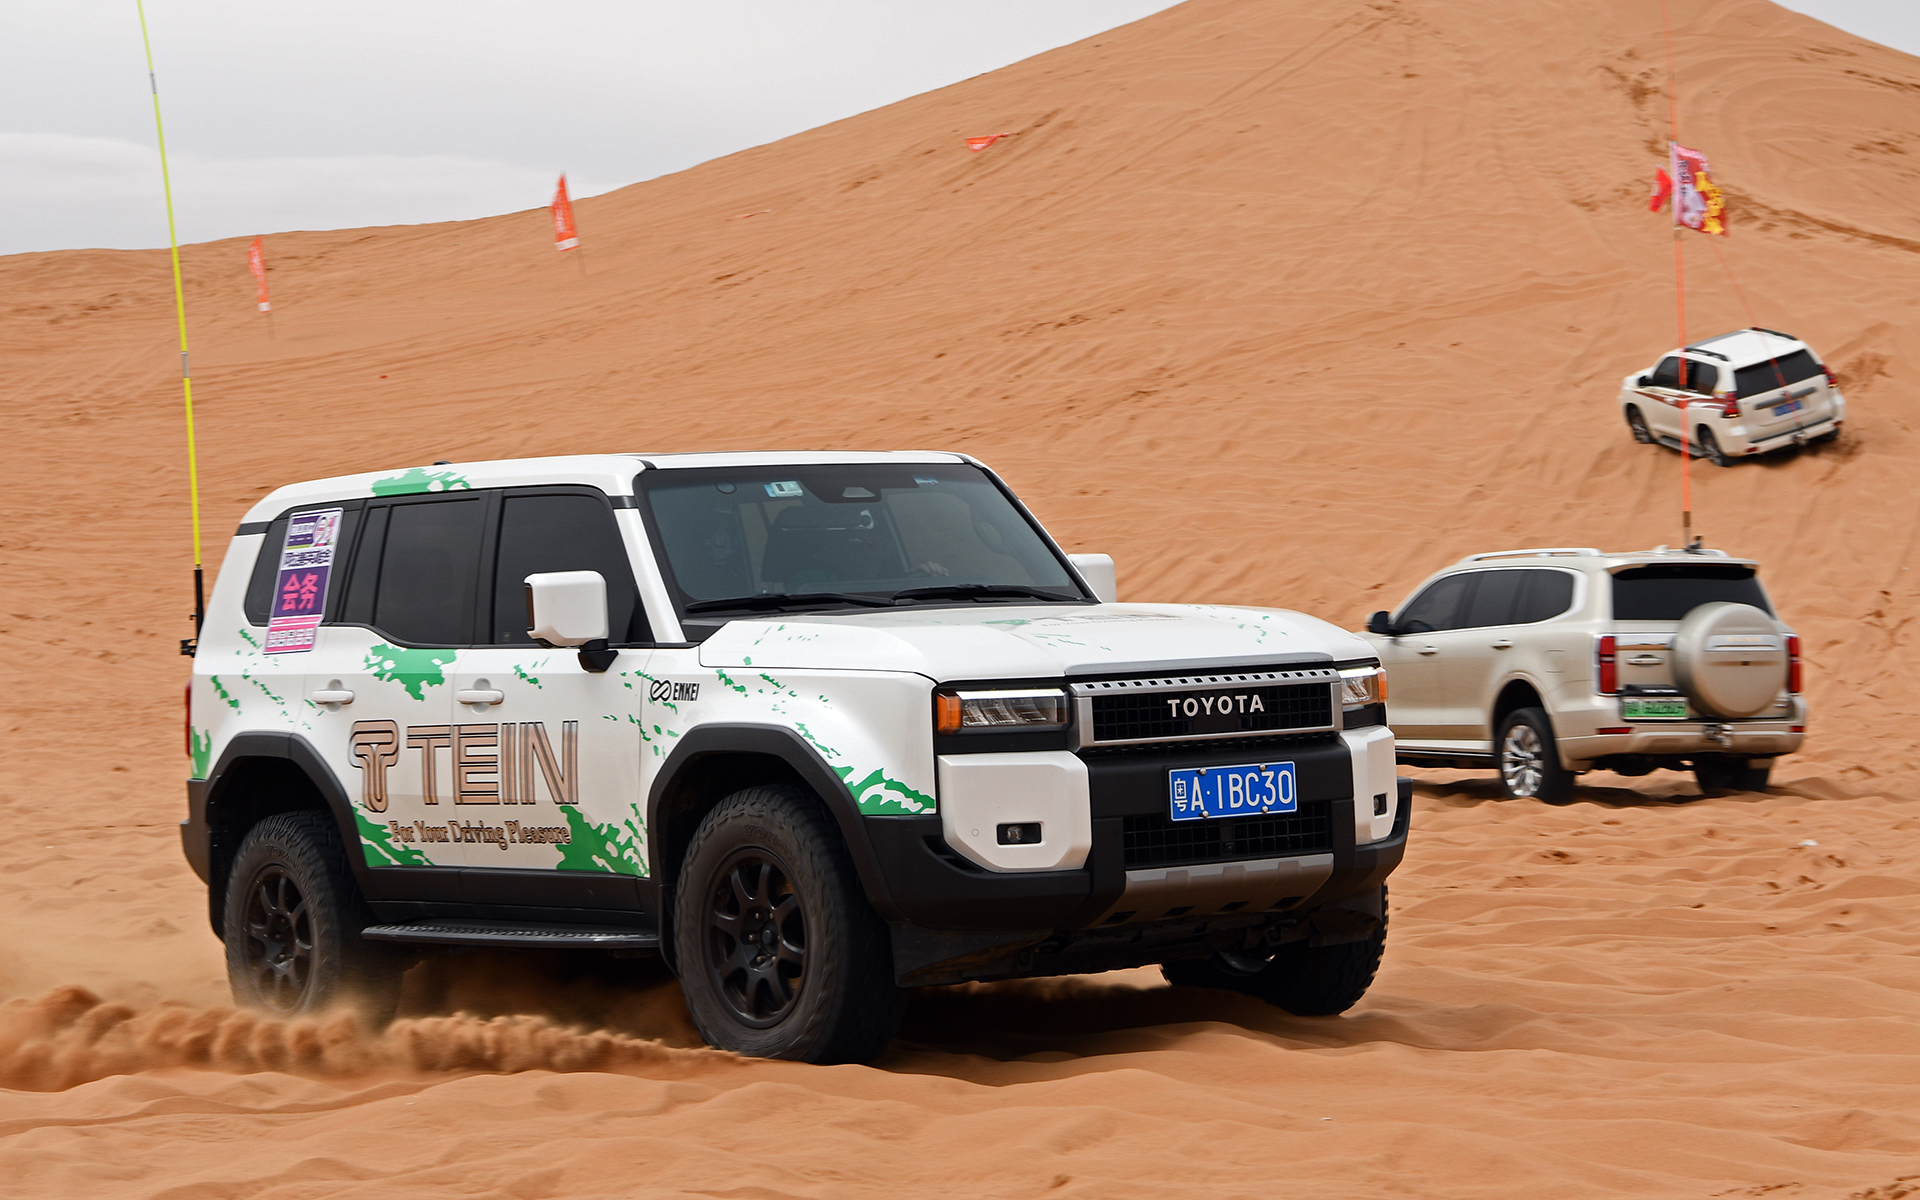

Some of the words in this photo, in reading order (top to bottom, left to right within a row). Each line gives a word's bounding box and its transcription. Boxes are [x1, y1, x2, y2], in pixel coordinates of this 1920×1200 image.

[282, 573, 319, 611] 会务
[673, 682, 700, 701] ENKEI
[1167, 694, 1265, 718] TOYOTA
[406, 720, 579, 806] TEIN
[389, 820, 413, 843] For
[413, 820, 450, 843] Your
[448, 820, 508, 851] Driving
[504, 820, 572, 845] Pleasure
